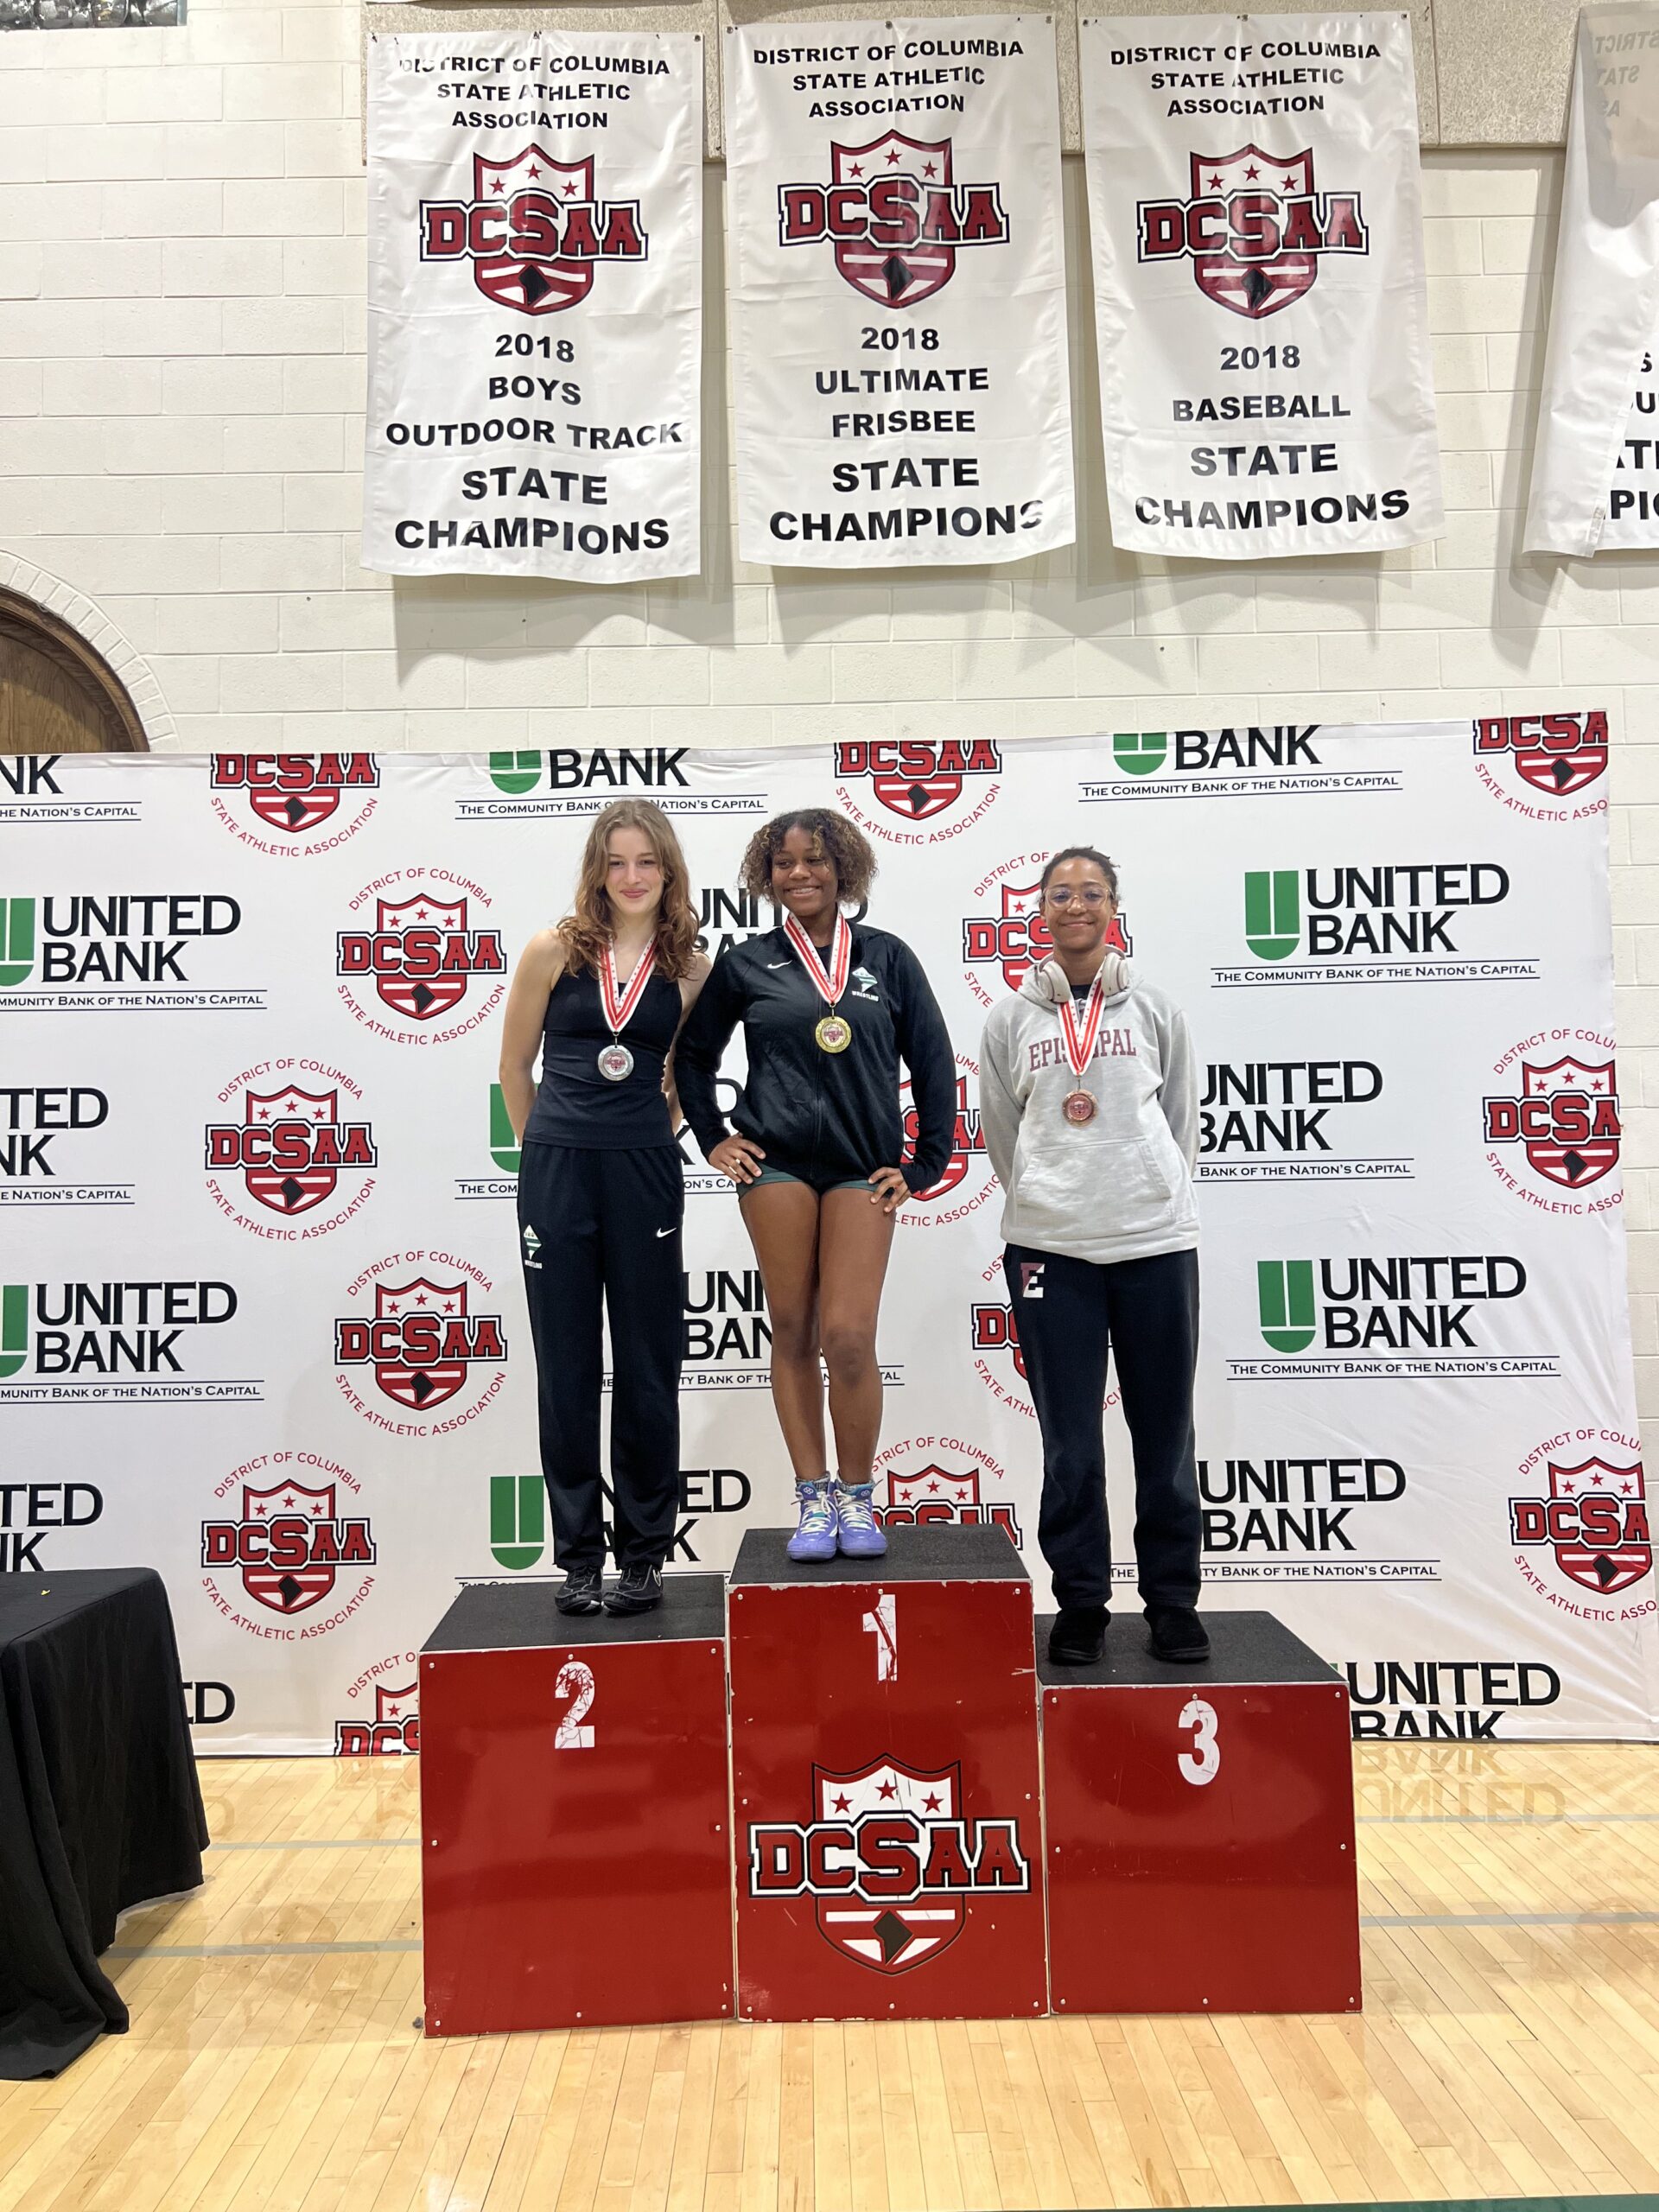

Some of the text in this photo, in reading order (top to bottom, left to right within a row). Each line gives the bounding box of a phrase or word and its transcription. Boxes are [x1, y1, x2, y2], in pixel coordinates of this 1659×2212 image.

[512, 57, 542, 72] OF
[550, 56, 670, 74] COLUMBIA
[753, 39, 1024, 65] DISTRICT OF COLUMBIA
[1110, 41, 1381, 65] DISTRICT OF COLUMBIA
[437, 83, 631, 101] STATE ATHLETIC
[792, 67, 985, 91] STATE ATHLETIC
[1150, 68, 1344, 90] STATE ATHLETIC
[452, 111, 608, 130] ASSOCIATION
[809, 94, 964, 118] ASSOCIATION
[1166, 95, 1325, 117] ASSOCIATION
[420, 188, 648, 261] DCSAA
[778, 173, 1010, 251] DCSAA
[1136, 188, 1370, 263] DCSAA
[494, 333, 575, 363] 2018
[861, 327, 939, 351] 2018
[1220, 345, 1300, 371] 2018
[488, 376, 582, 406] BOYS
[815, 367, 989, 395] ULTIMATE
[832, 410, 976, 438] FRISBEE
[1172, 395, 1351, 423] BASEBALL
[385, 417, 683, 449] OUTDOOR TRACK
[832, 457, 980, 493] STATE
[1190, 442, 1338, 477] STATE
[461, 466, 607, 505] STATE
[769, 499, 1044, 542] CHAMPIONS
[1135, 489, 1410, 530] CHAMPIONS
[394, 518, 670, 555] CHAMPIONS
[1174, 724, 1323, 771] BANK
[1473, 711, 1608, 755] DCSA
[210, 753, 380, 793] DCSAA
[548, 747, 691, 790] BANK
[834, 739, 1002, 781] DCSAA
[459, 804, 485, 815] THE
[488, 803, 563, 814] COMMUNITY
[566, 801, 601, 811] BANK
[711, 798, 764, 809] CAPITAL
[1083, 787, 1109, 797] THE
[1112, 784, 1188, 795] COMMUNITY
[1192, 782, 1228, 792] BANK
[1232, 782, 1249, 791] OF
[1280, 778, 1341, 788] NATION'S
[1344, 776, 1399, 786] CAPITAL
[1475, 764, 1567, 821] STATE ATHLETIC
[20, 806, 138, 817] NATION'S CAPITAL
[211, 798, 378, 857] STATE ATHLETIC ASSOCIATION
[836, 784, 1001, 845] STATE ATHLETIC ASSOCIATION
[348, 868, 493, 911] DISTRICT OF COLUMBIA
[974, 852, 1050, 897] DISTRICT OF
[1306, 862, 1510, 909] UNITED
[42, 894, 241, 937] UNITED
[1307, 911, 1459, 956] BANK
[41, 940, 189, 982] BANK
[336, 925, 507, 981] DCSAA
[1215, 963, 1535, 982] THE COMMUNITY BANK OF THE NATION'S CAPITAL
[58, 995, 264, 1006] BANK OF THE NATION'S CAPITAL
[964, 971, 994, 1008] STATE
[338, 984, 505, 1045] STATE ATHLETIC ASSOCIATION
[1028, 1028, 1137, 1072] EPIPAL
[1493, 1028, 1571, 1075] DISTRICT OF
[218, 1058, 364, 1103] DISTRICT OF COLUMBIA
[205, 1118, 378, 1174] DCSAA
[12, 1190, 130, 1199] NATION'S CAPITAL
[1486, 1152, 1582, 1215] STATE ATHLETIC
[206, 1178, 376, 1241] STATE ATHLETIC ASSOCIATION
[346, 1251, 493, 1296] DISTRICT OF COLUMBIA
[1020, 1262, 1045, 1298] E
[1319, 1255, 1527, 1301] UNITED
[35, 1281, 238, 1326] UNITED
[334, 1312, 508, 1369] DCSAA
[1323, 1304, 1478, 1349] BANK
[35, 1330, 185, 1374] BANK
[1230, 1360, 1556, 1375] THE COMMUNITY BANK OF THE NATION'S CAPITAL
[52, 1386, 259, 1397] BANK OF THE NATION'S CAPITAL
[336, 1372, 506, 1437] STATE ATHLETIC ASSOCIATION
[939, 1437, 1005, 1479] COLUMBIA
[1518, 1428, 1595, 1475] DISTRICT OF
[214, 1452, 361, 1497] DISTRICT OF COLUMBIA
[1197, 1458, 1407, 1503] UNITED
[201, 1514, 377, 1571] DCSAA
[1202, 1508, 1357, 1552] BANK
[202, 1576, 375, 1640] STATE ATHLETIC ASSOCIATION
[1514, 1555, 1616, 1622] STATE ATHLETIC
[862, 1593, 898, 1681] 1
[554, 1661, 595, 1749] 2
[1345, 1662, 1560, 1706] UNITED
[1177, 1699, 1220, 1786] 3
[747, 1810, 1032, 1904] DCSAA
